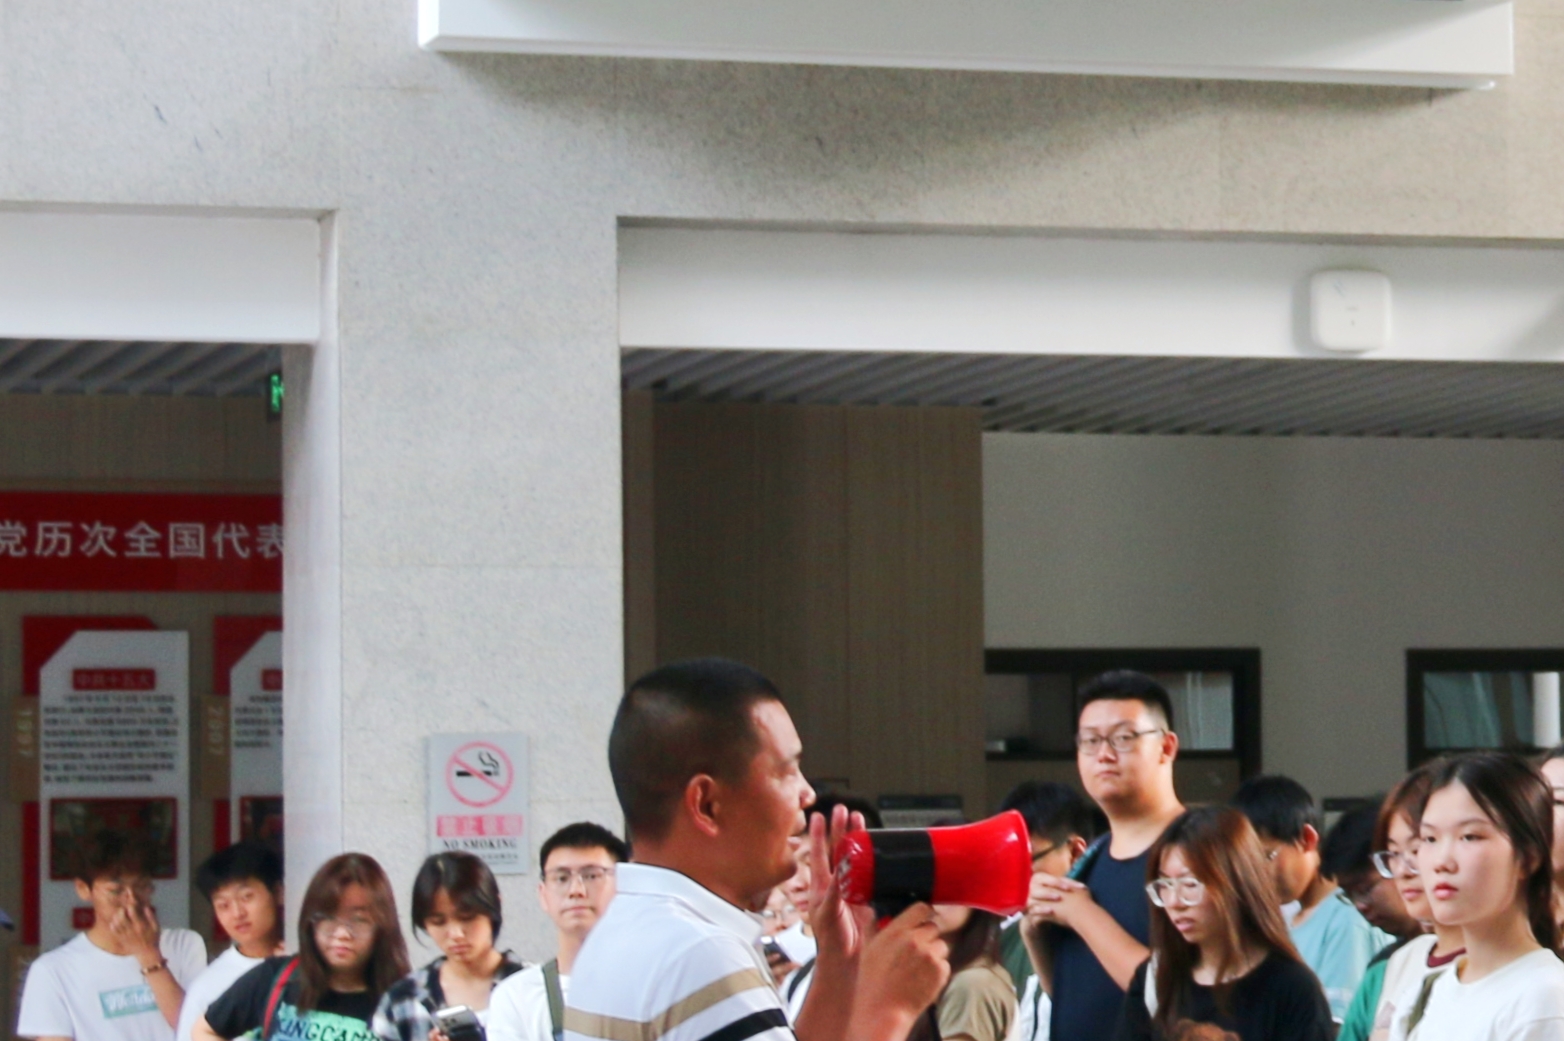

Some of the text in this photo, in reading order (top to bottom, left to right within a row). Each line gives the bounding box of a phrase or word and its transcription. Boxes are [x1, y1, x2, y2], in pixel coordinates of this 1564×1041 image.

[0, 520, 283, 559] 党历次全国代表
